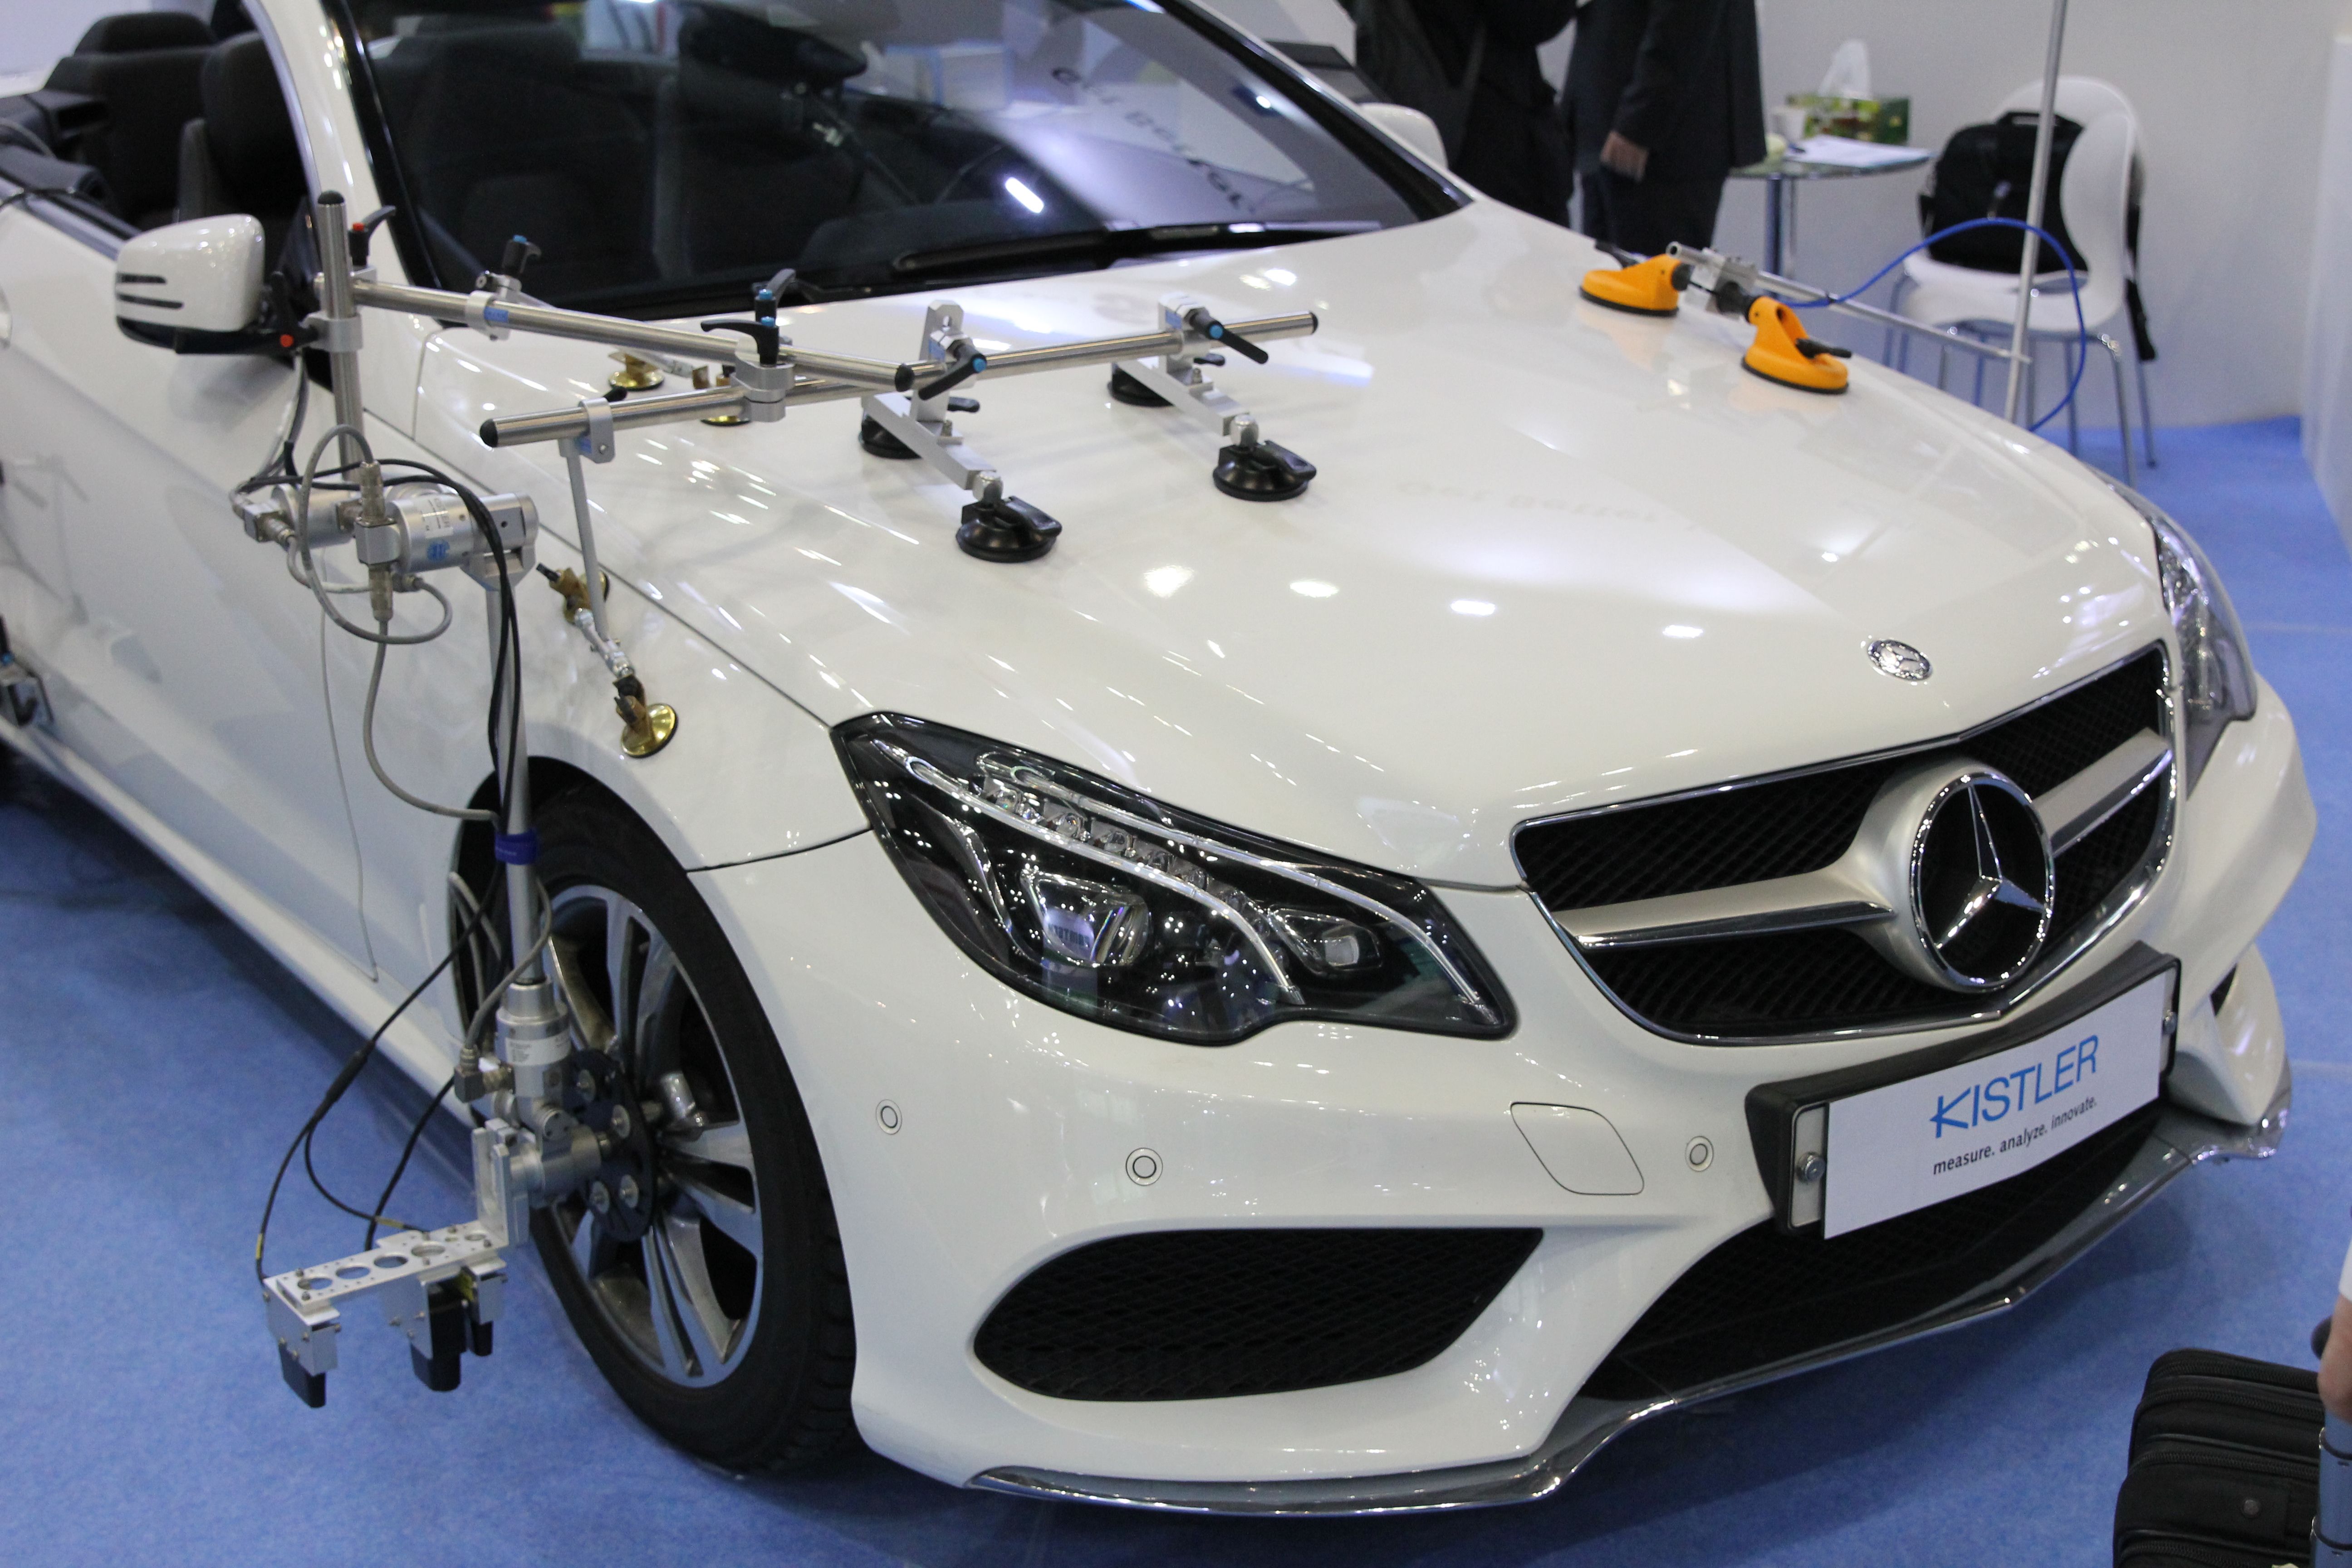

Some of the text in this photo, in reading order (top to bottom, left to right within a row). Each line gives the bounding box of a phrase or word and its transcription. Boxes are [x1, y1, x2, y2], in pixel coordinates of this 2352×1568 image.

[1929, 1034, 2099, 1138] KISTLER
[1933, 1095, 2097, 1175] measure. analyze. innovate.
